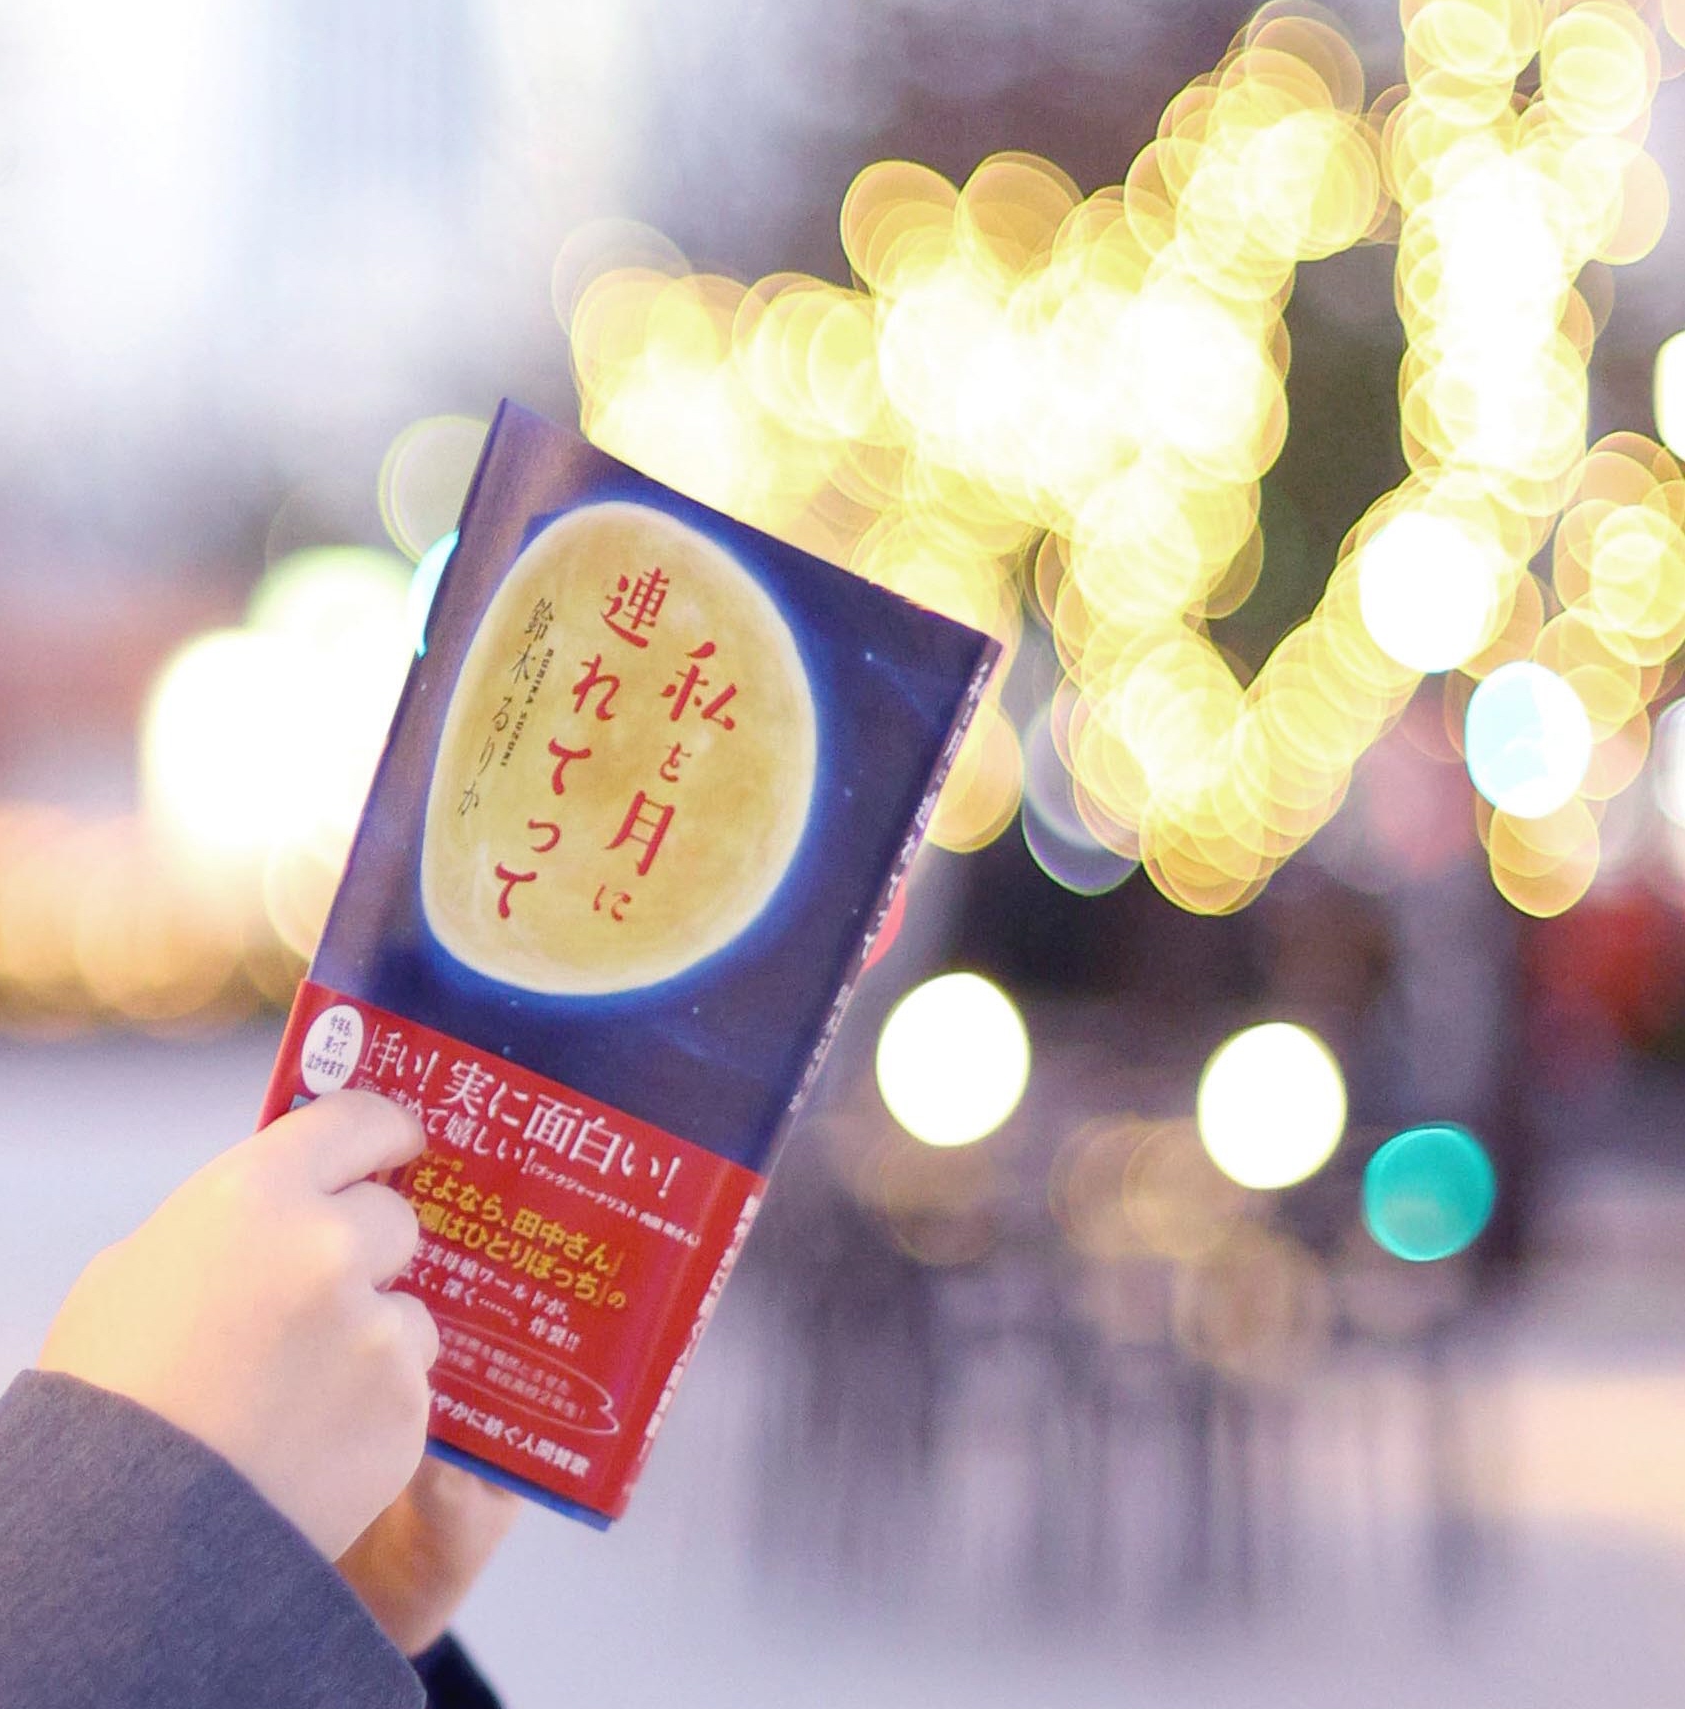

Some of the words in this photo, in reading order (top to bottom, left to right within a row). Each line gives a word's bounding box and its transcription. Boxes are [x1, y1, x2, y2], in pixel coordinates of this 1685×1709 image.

[458, 598, 555, 816] 鈴木るりか
[494, 566, 670, 919] 連れてって
[500, 710, 531, 767] SUZUKI
[526, 647, 555, 705] RURIKA
[592, 641, 738, 921] 私を月に
